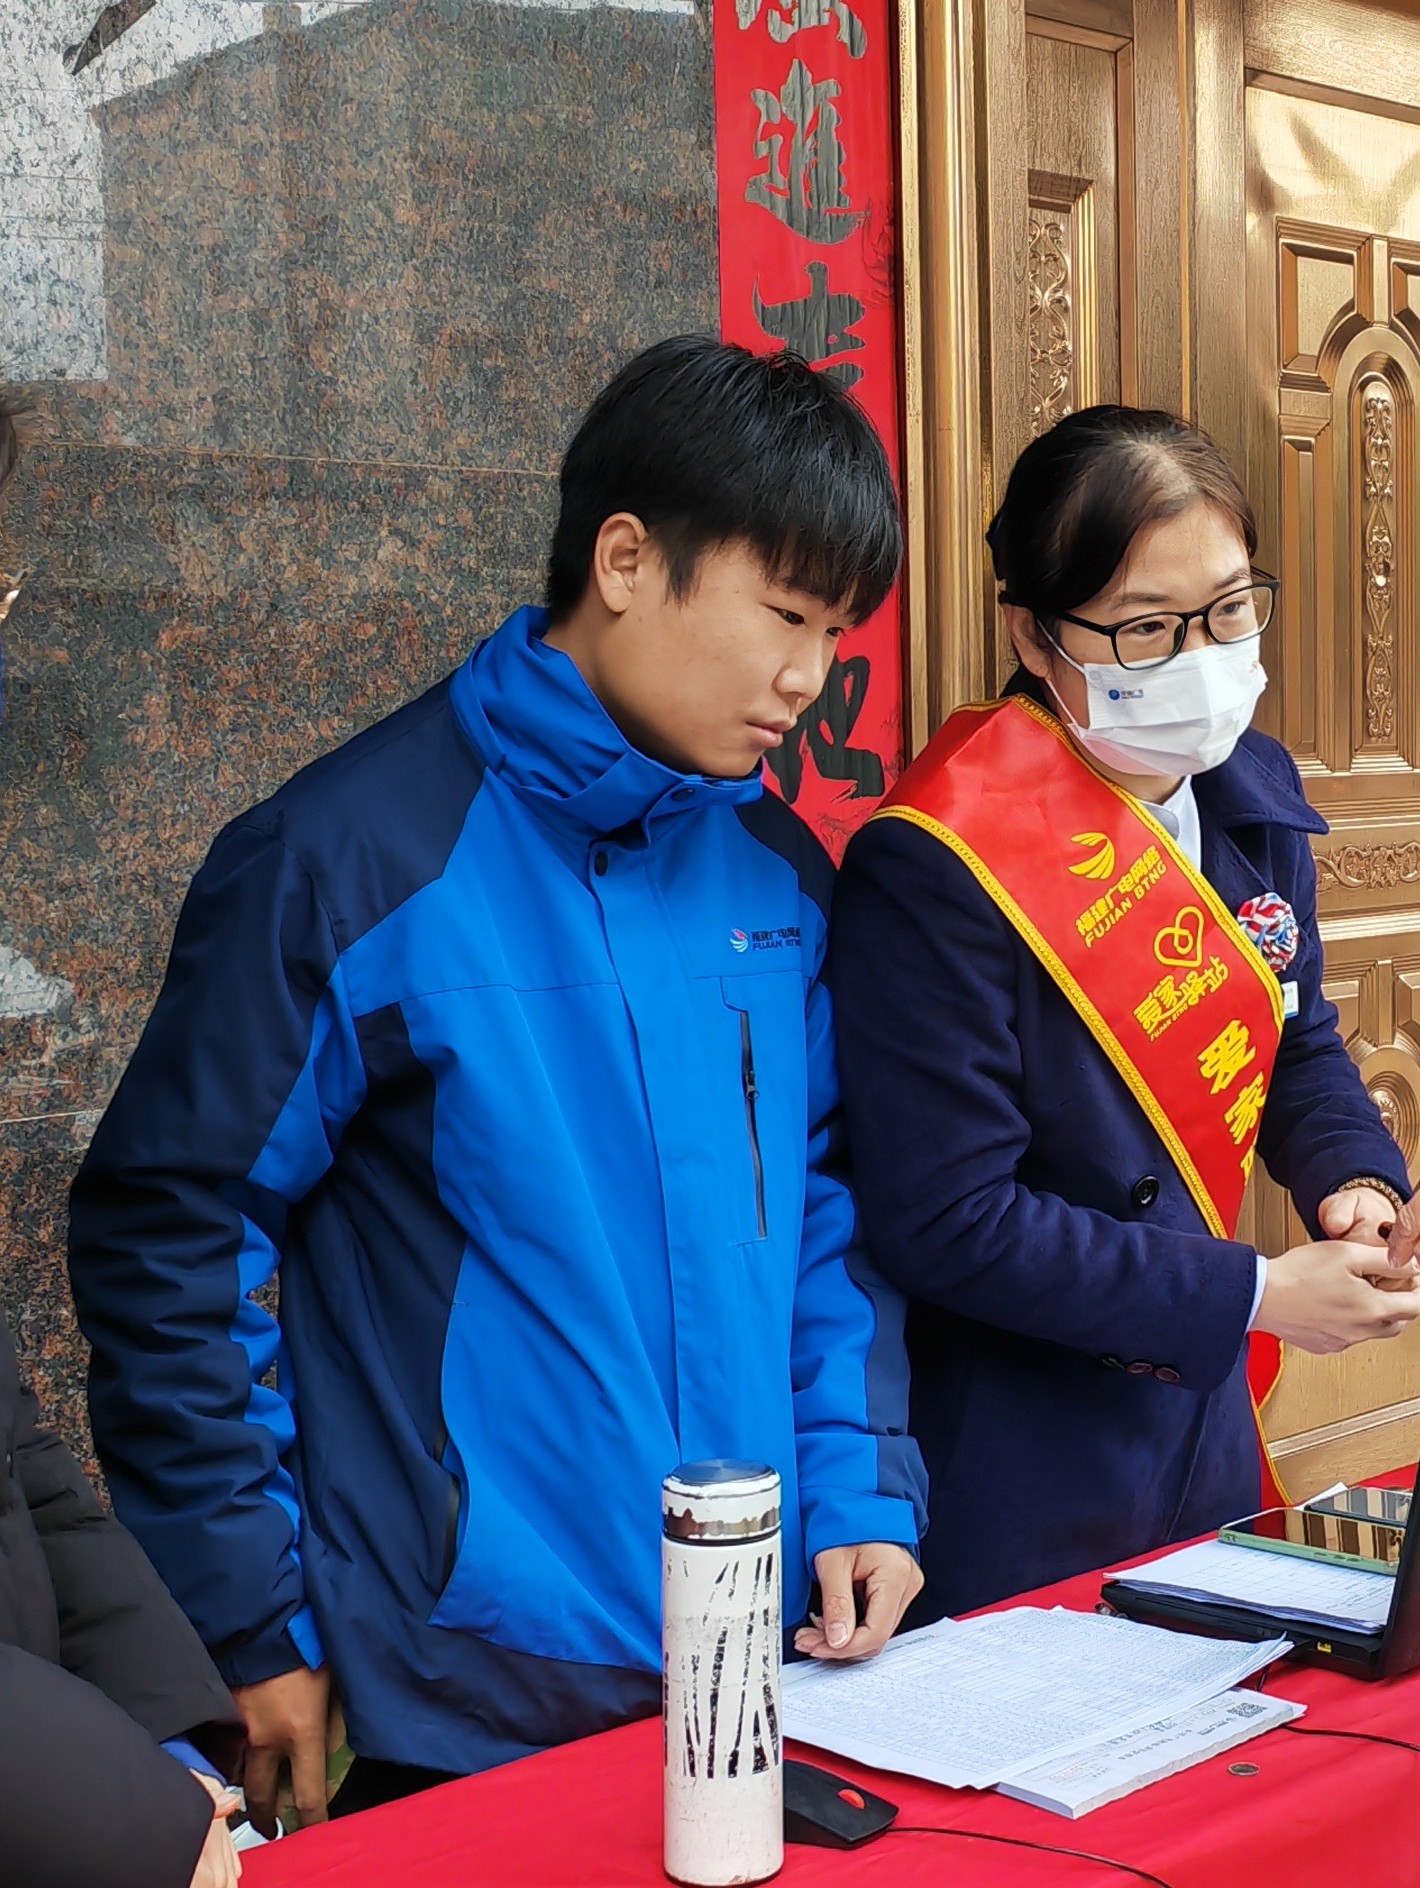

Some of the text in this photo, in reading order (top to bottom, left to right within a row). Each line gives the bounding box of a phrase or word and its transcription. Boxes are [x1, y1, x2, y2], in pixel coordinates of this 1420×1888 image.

[1075, 844, 1161, 936] 福建广电网络
[1084, 859, 1168, 948] FUJIAN BTNG
